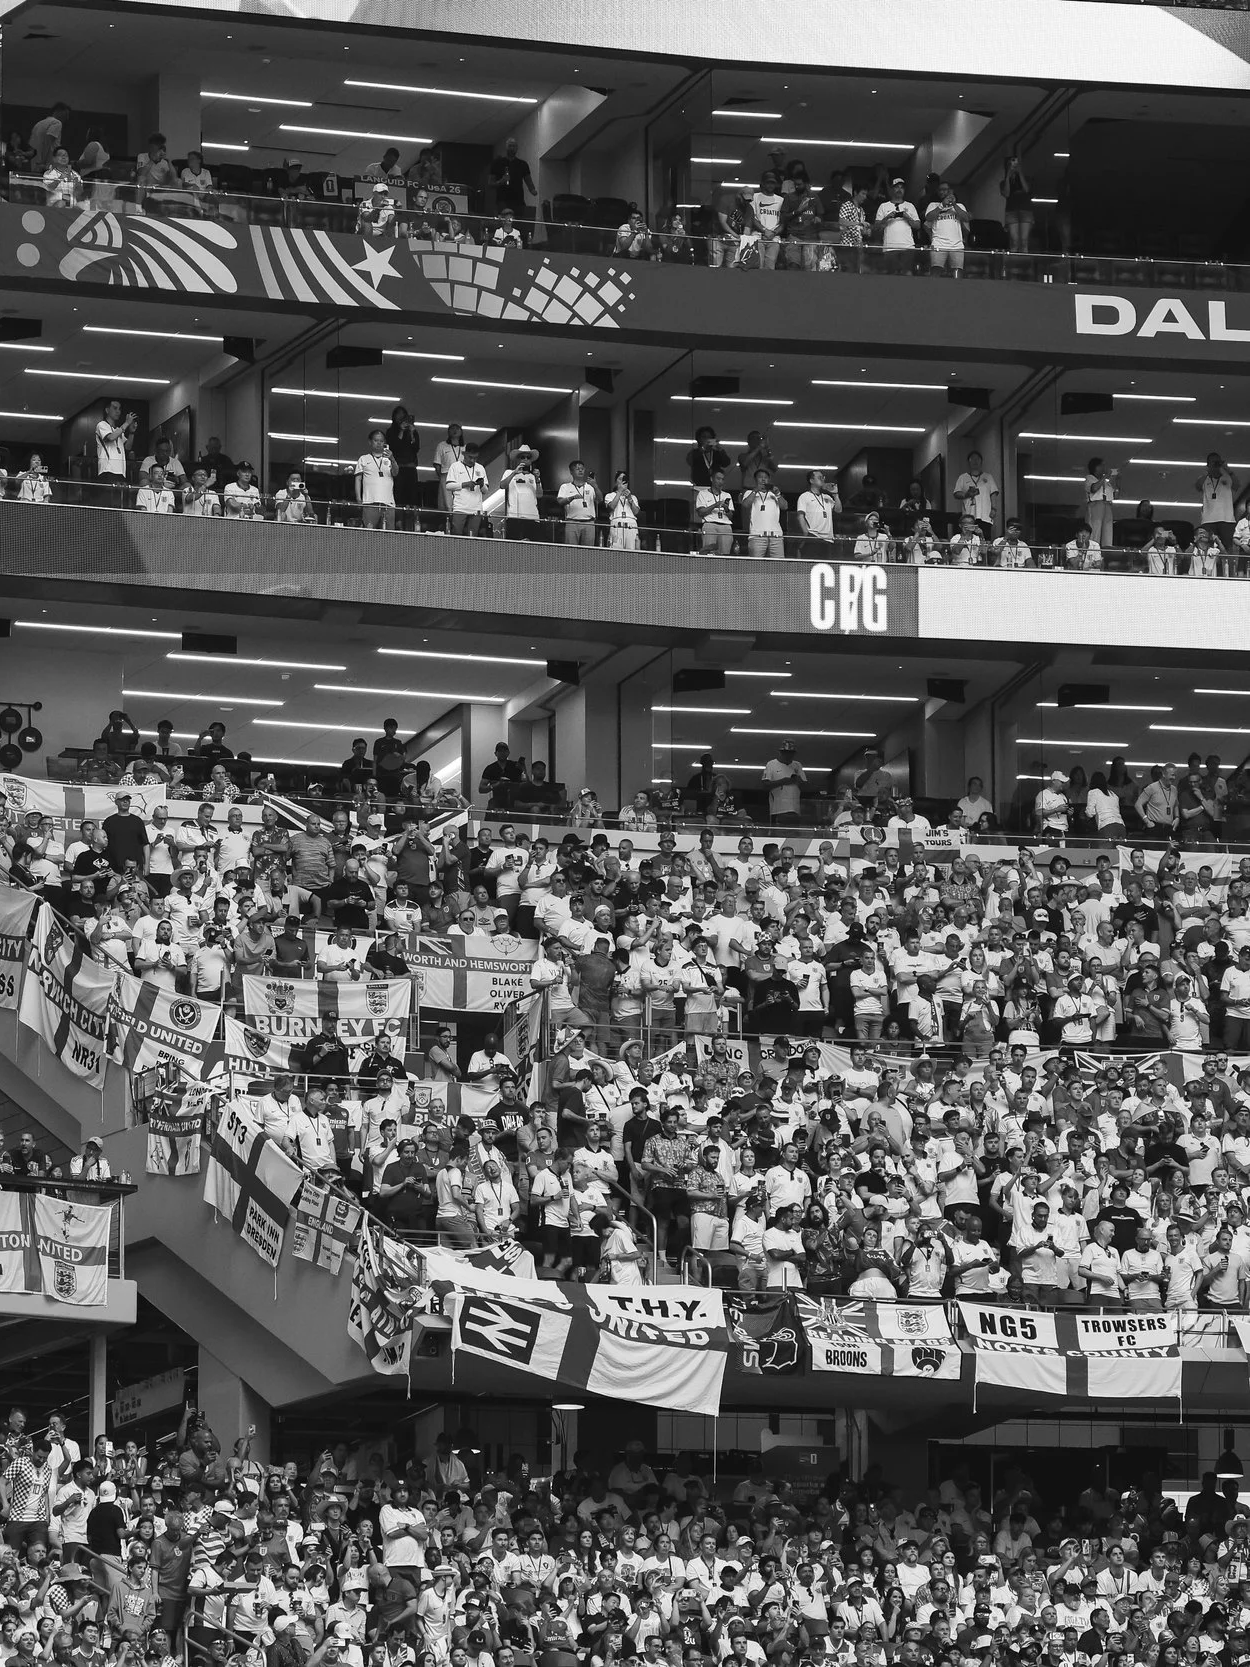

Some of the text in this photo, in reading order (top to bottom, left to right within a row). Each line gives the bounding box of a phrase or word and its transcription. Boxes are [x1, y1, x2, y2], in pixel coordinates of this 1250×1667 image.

[924, 838, 952, 847] TOURS
[925, 828, 949, 838] JIM'S
[444, 957, 468, 969] AND
[28, 947, 80, 1024] NRWICH
[492, 977, 524, 987] BLAKE
[489, 989, 525, 999] OLIVER
[493, 1001, 521, 1011] RYN
[255, 1016, 401, 1037] BURNEY FC
[149, 1025, 204, 1055] UNITED
[71, 1040, 100, 1074] NR31
[157, 1049, 186, 1066] BRING
[227, 1110, 248, 1145] ST3
[249, 1205, 281, 1245] PARK INN
[307, 1216, 334, 1236] ENGLAND
[37, 1238, 84, 1262] NITED
[246, 1222, 278, 1262] DRESDEN
[978, 1311, 1038, 1341] NG5
[1081, 1317, 1168, 1334] TROWSERS
[976, 1336, 1171, 1359] NOTTS COUNTY
[1117, 1335, 1137, 1347] FC
[825, 1349, 868, 1368] BROONS
